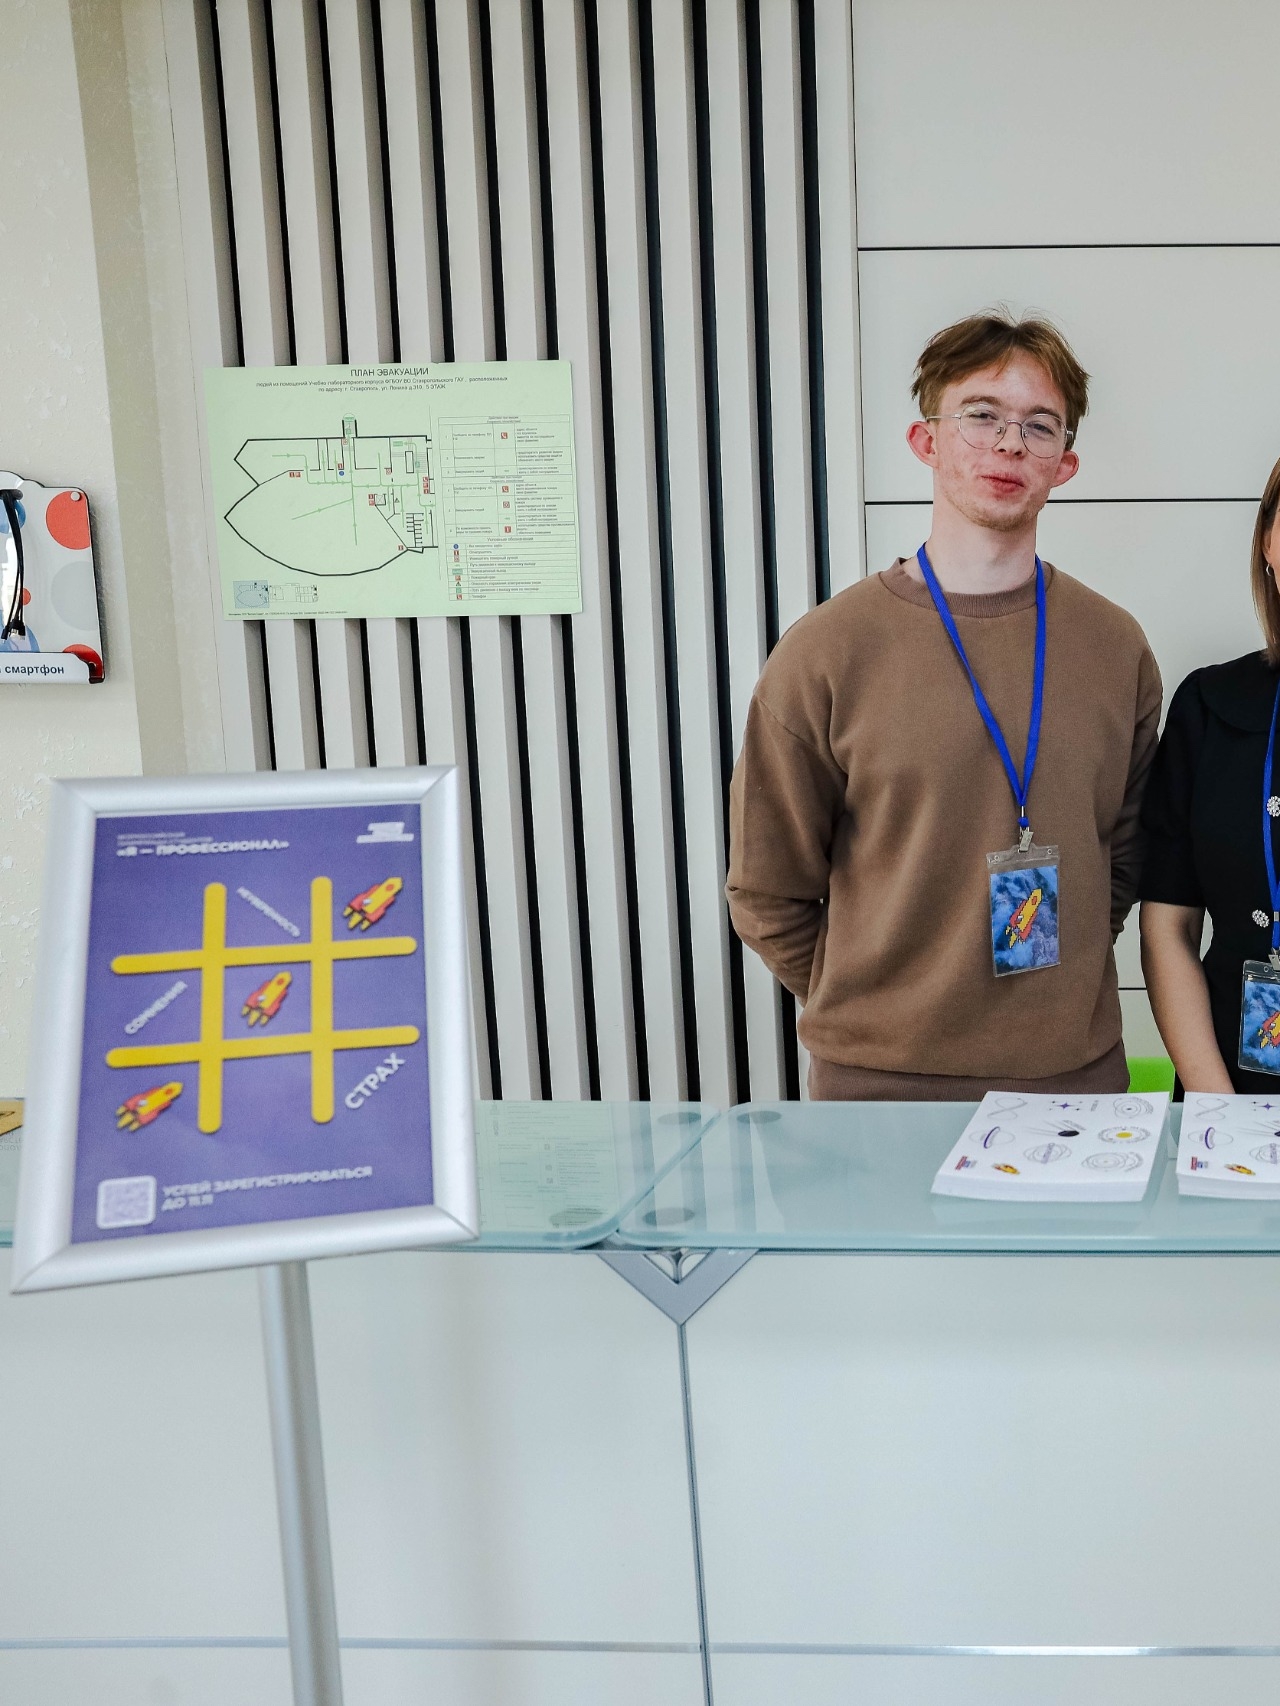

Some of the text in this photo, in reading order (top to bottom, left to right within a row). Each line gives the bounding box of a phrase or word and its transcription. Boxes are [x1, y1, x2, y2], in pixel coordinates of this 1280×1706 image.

[350, 367, 430, 377] ПЛАН ЭВАКУАЦИИ
[5, 664, 65, 676] смартфон
[344, 1052, 406, 1109] СТРАХ
